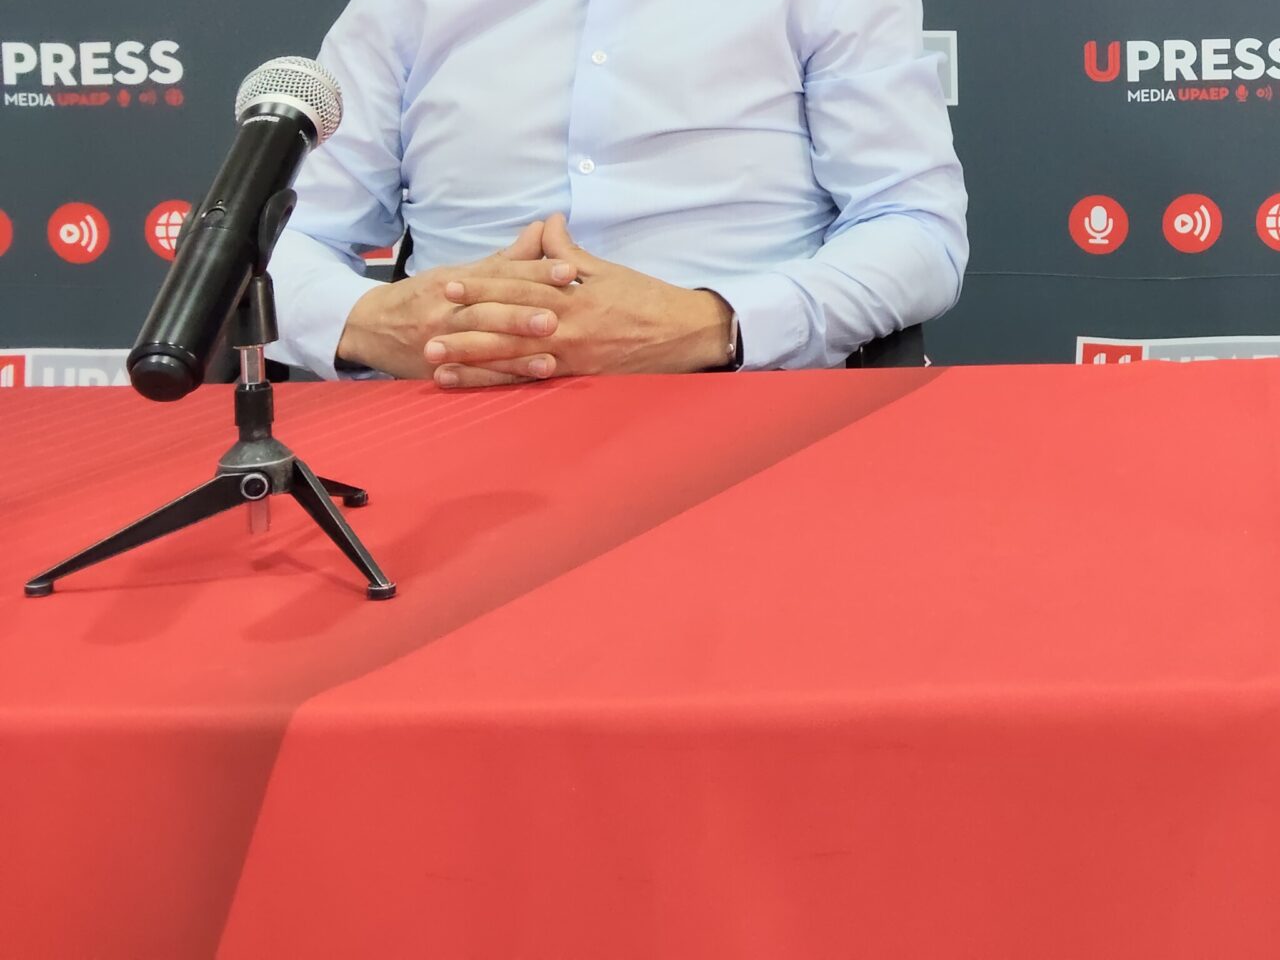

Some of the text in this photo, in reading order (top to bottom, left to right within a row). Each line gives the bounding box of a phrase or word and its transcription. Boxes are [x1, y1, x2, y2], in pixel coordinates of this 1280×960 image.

[2, 41, 183, 86] PRESS
[5, 93, 54, 106] MEDIA
[1128, 89, 1175, 102] MEDIA
